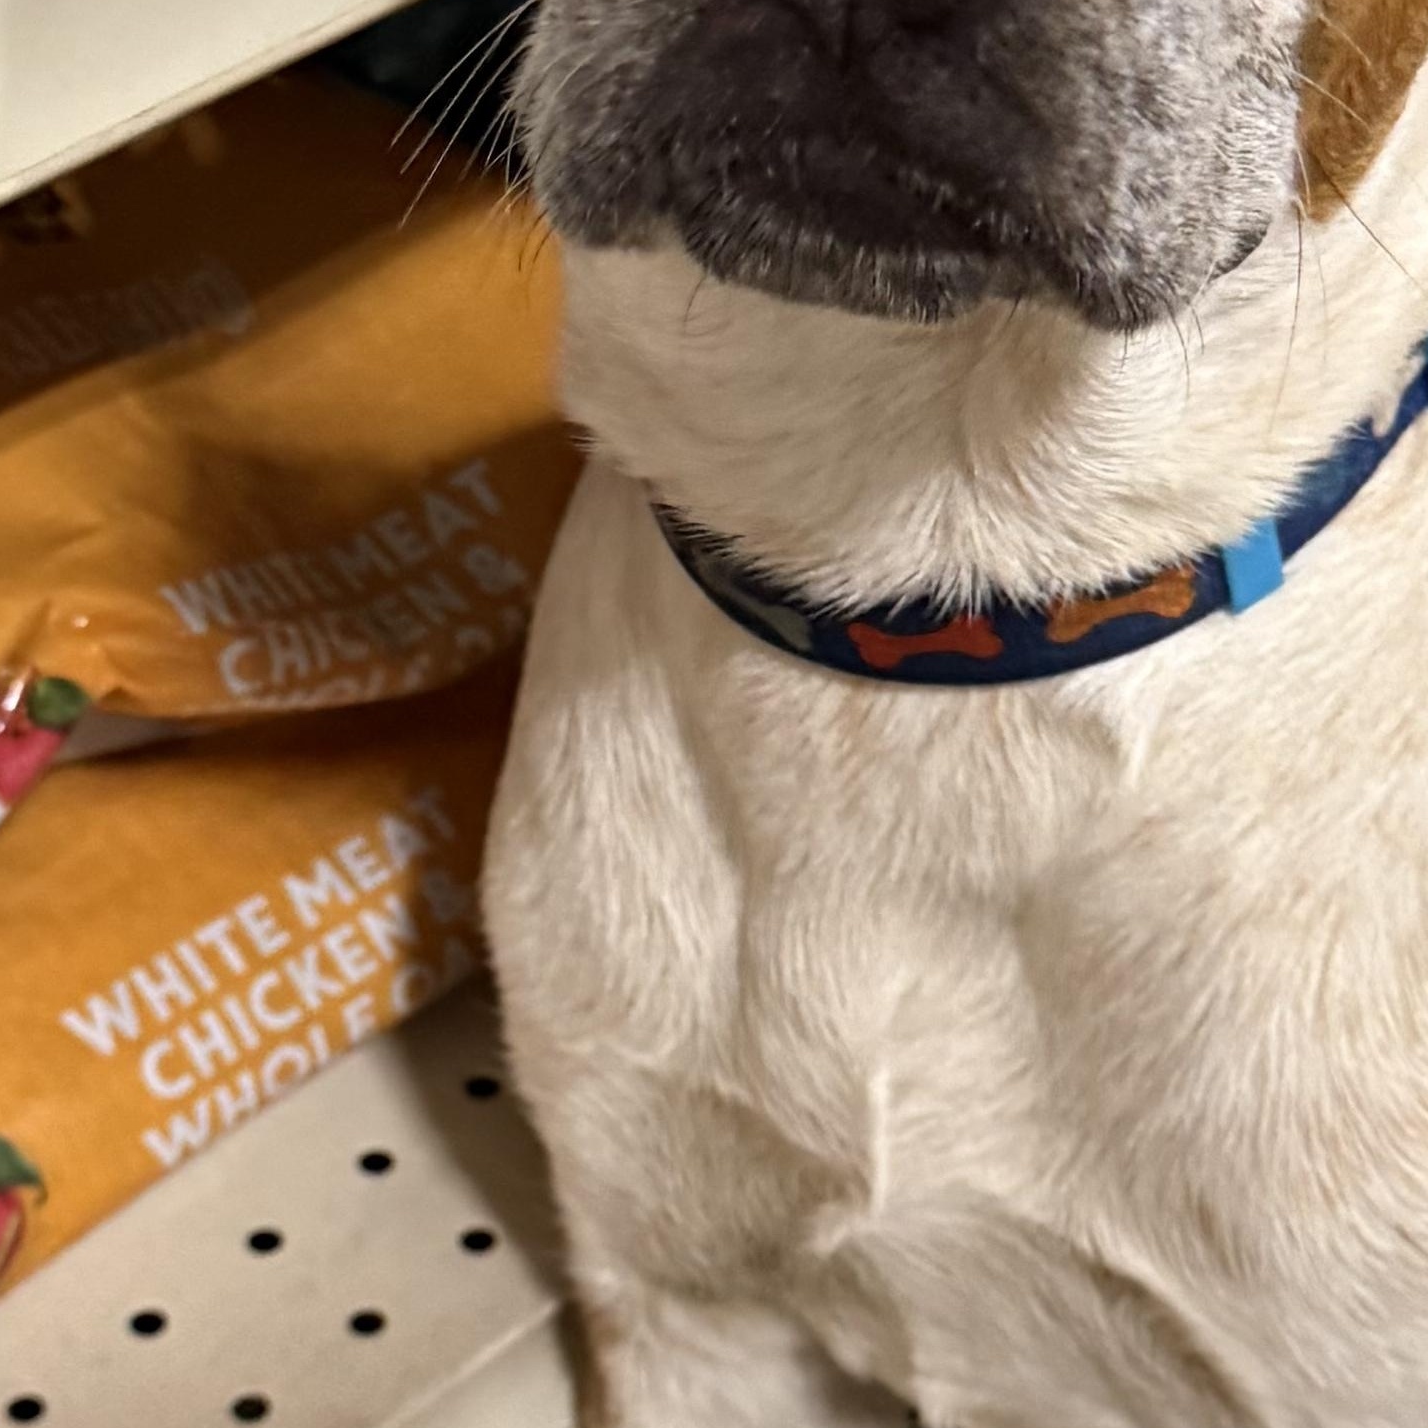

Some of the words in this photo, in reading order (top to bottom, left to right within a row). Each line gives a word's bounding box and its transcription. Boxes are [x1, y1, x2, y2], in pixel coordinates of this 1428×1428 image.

[329, 456, 505, 593] MEAT
[60, 892, 292, 1060] WHITE
[282, 785, 458, 927] MEAT
[139, 888, 423, 1103] CHICKEN
